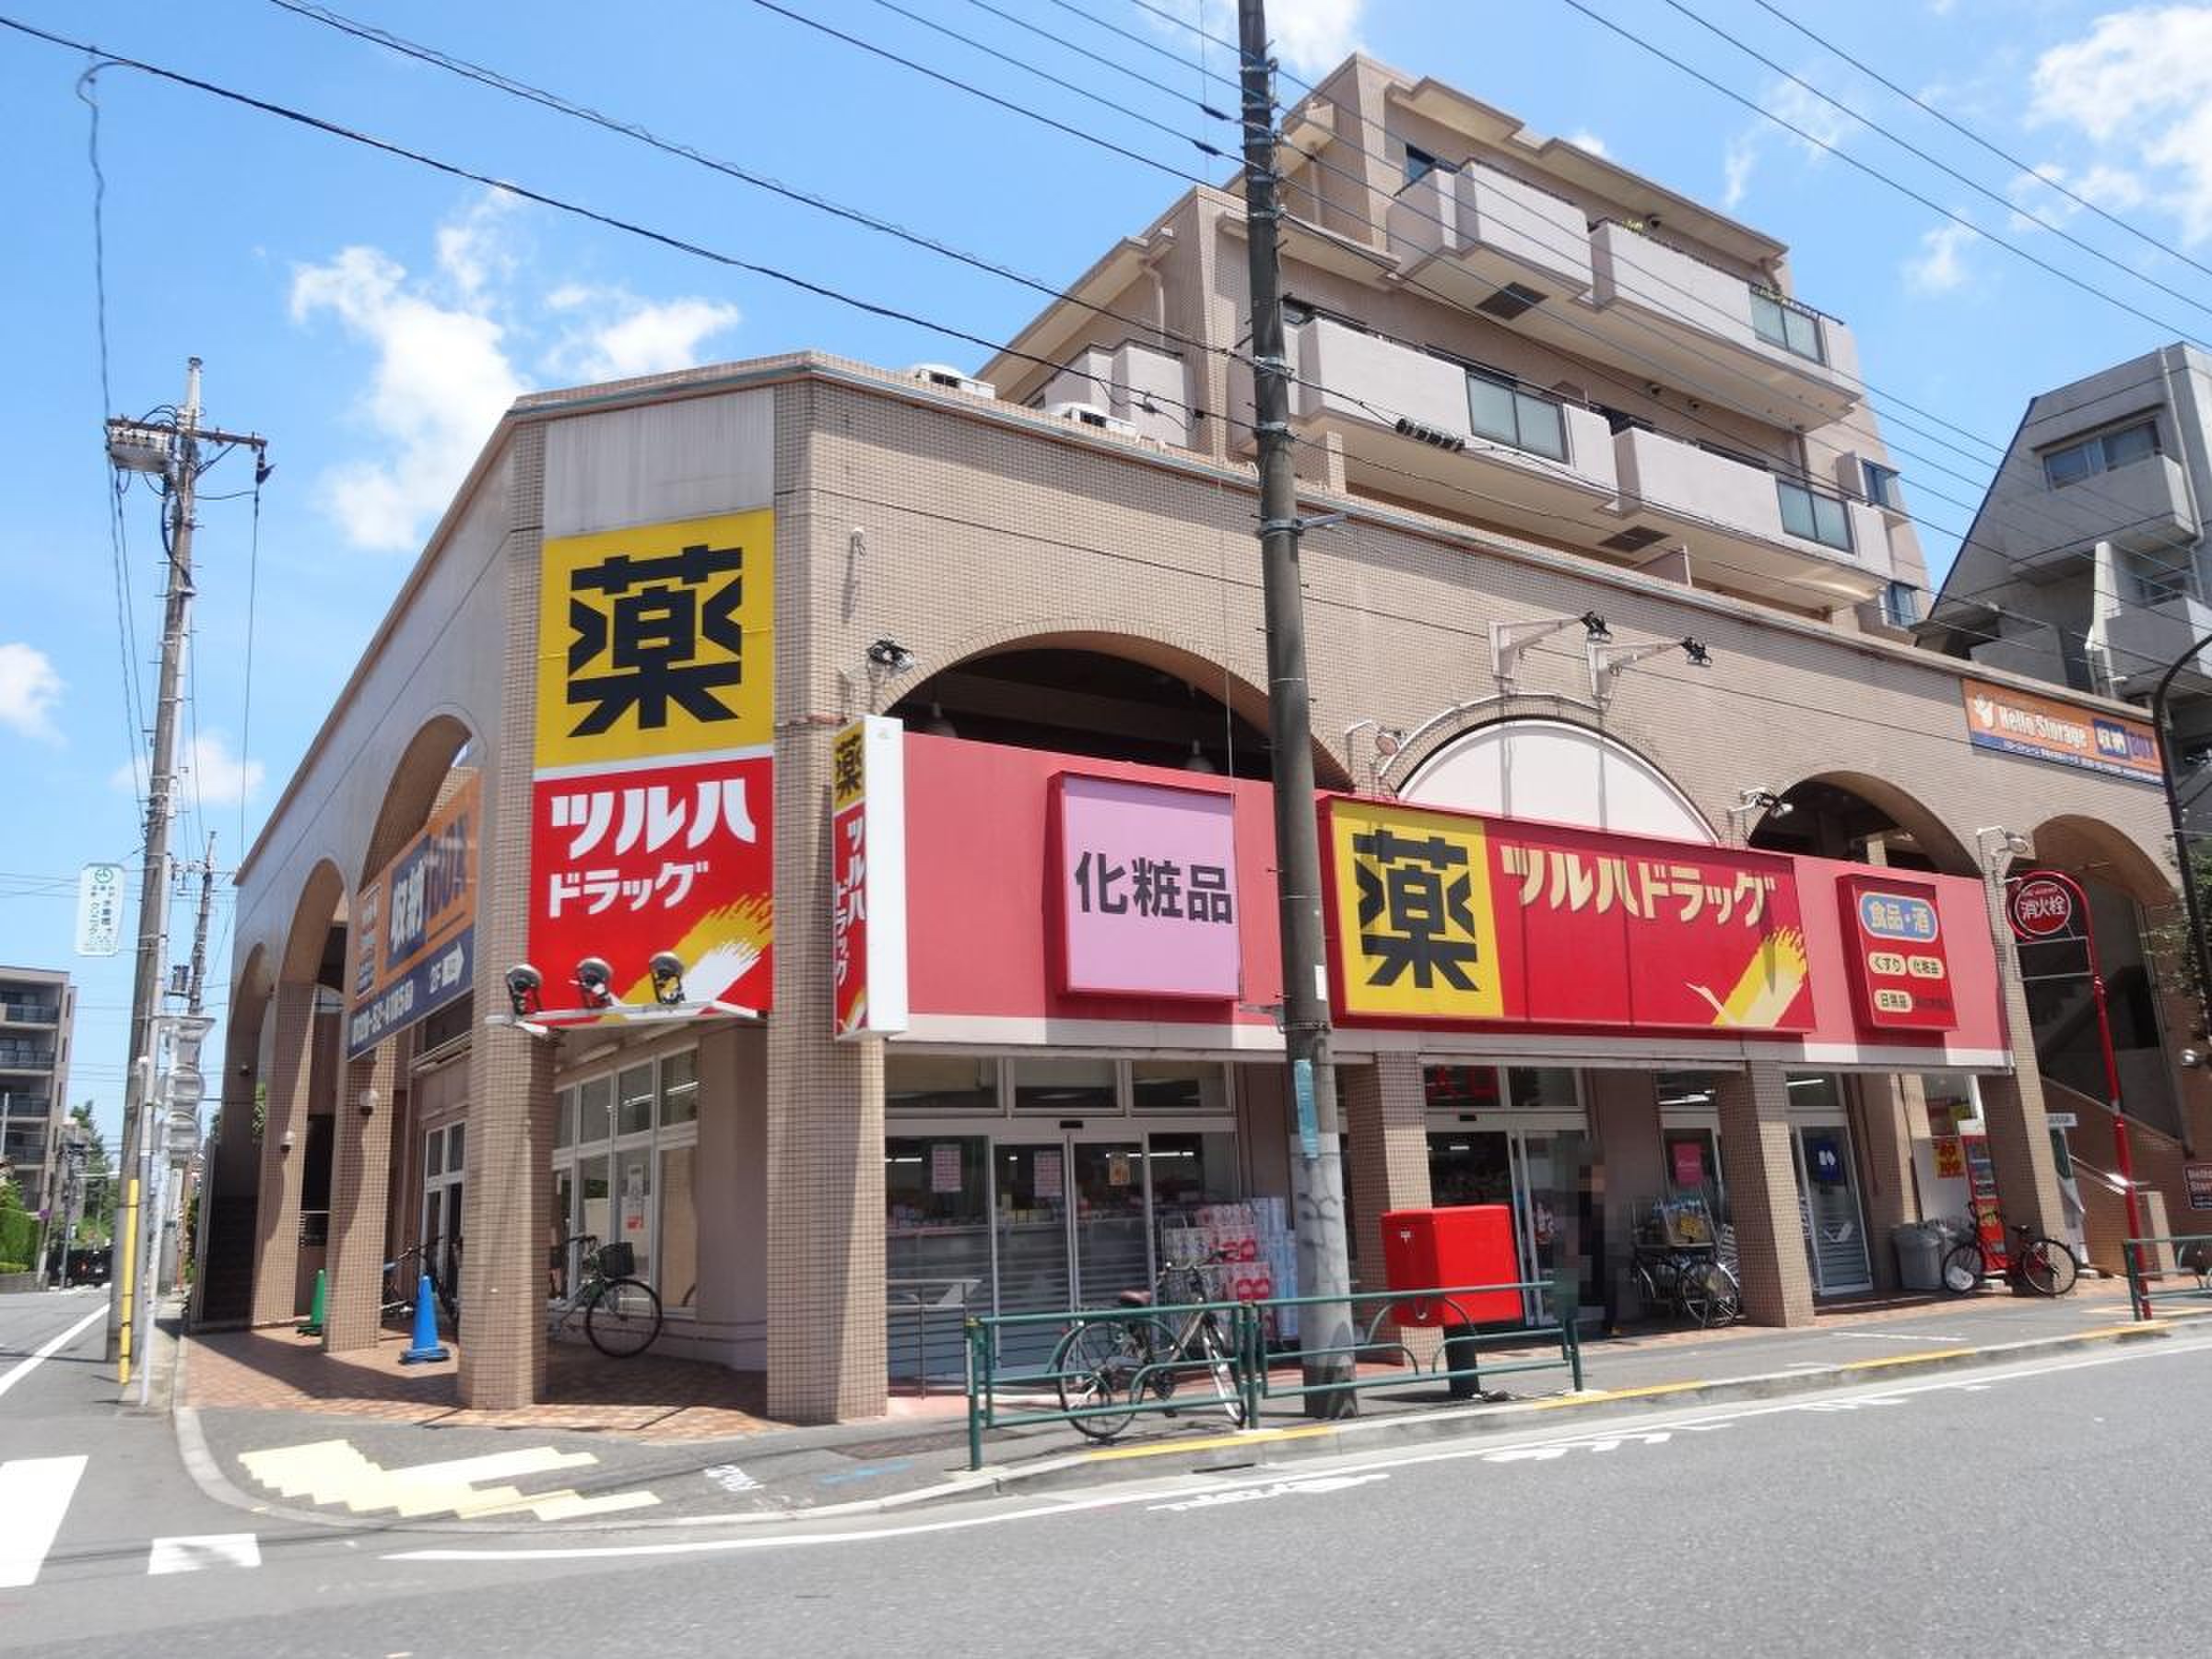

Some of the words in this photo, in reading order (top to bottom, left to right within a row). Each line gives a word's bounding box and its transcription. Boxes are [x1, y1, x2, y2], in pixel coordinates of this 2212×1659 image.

[567, 545, 743, 737] 薬
[1998, 706, 2035, 735] Hello
[2036, 715, 2088, 747] Storage
[835, 734, 861, 799] 薬
[551, 779, 756, 860] ツルハ
[549, 862, 709, 918] ドラッグ
[847, 817, 865, 926] ツルハ
[1075, 851, 1233, 924] 化粧品
[1500, 845, 1776, 928] ツルハドラッグ
[2020, 896, 2065, 920] 消火栓
[1352, 830, 1480, 992] 薬
[1875, 957, 1901, 972] くすり
